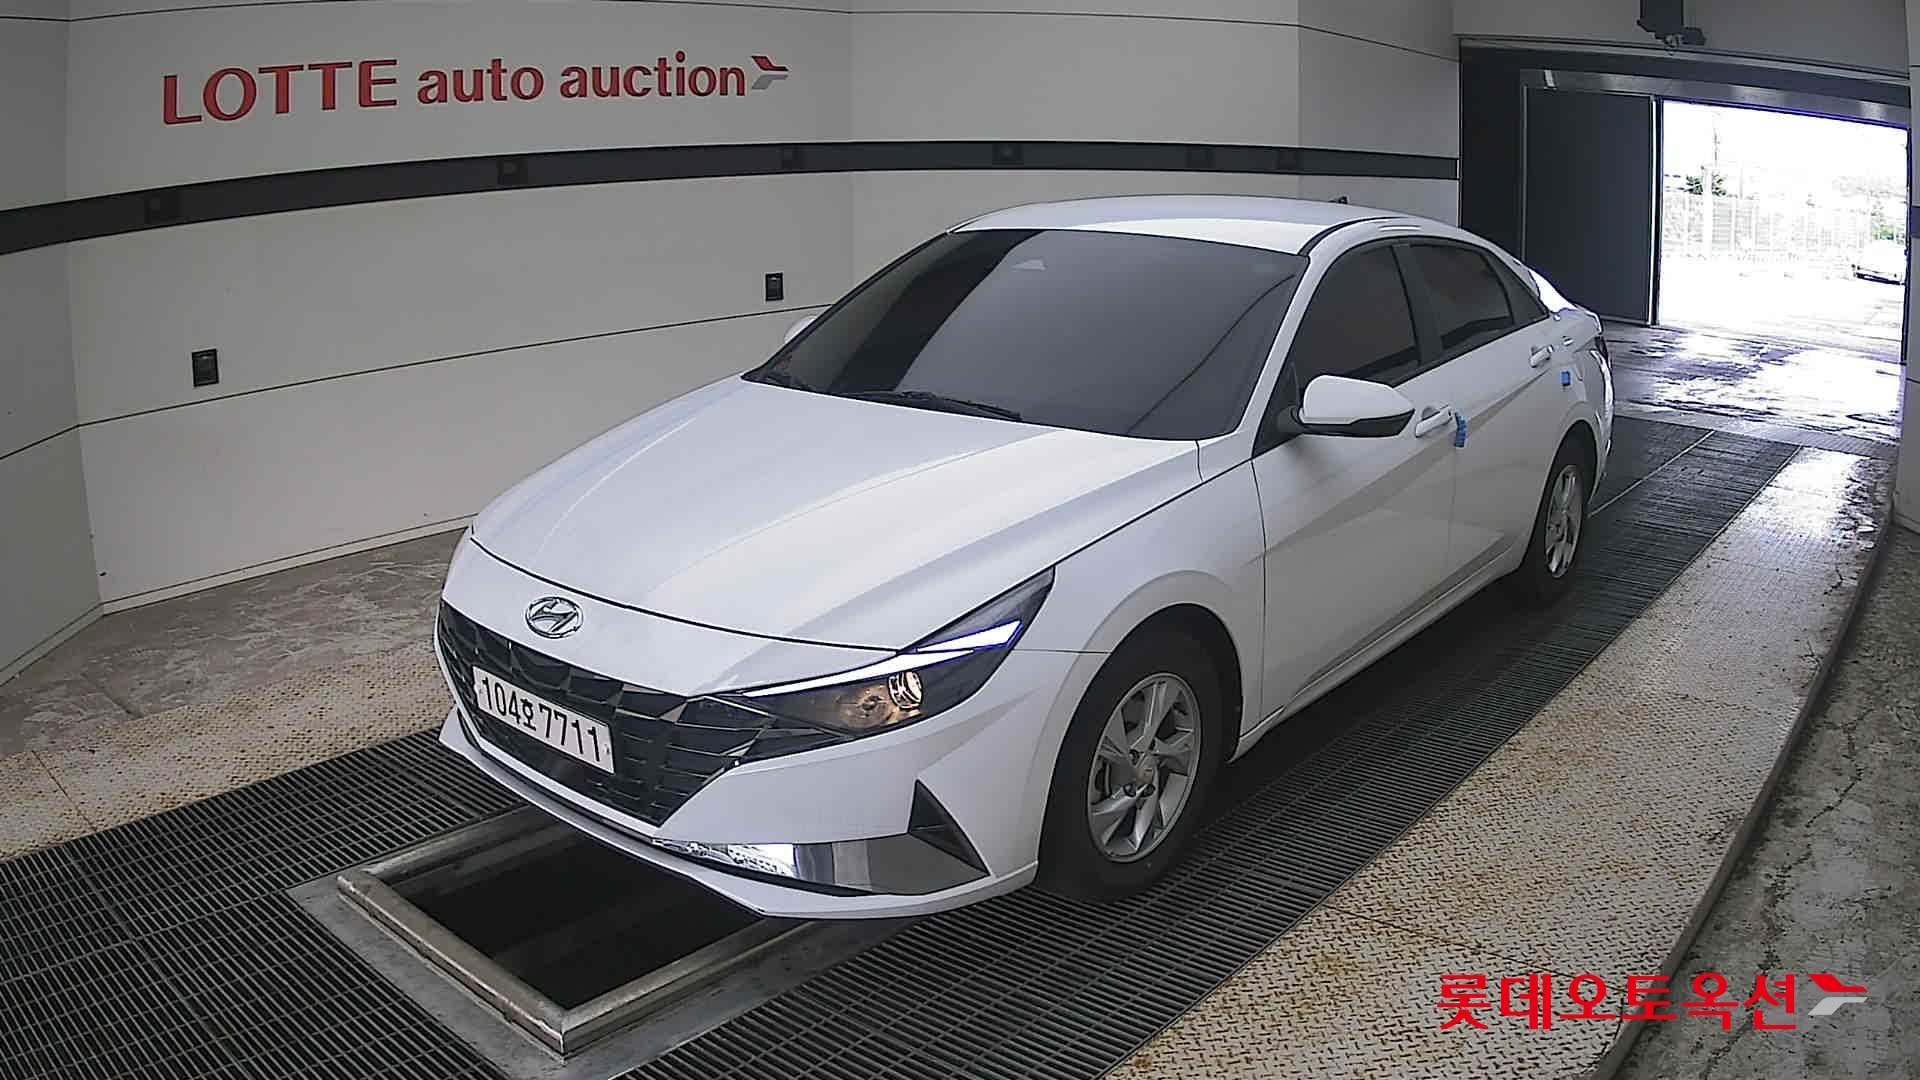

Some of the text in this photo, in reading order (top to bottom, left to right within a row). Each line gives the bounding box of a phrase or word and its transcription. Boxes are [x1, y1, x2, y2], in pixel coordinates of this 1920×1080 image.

[163, 51, 746, 125] LOTTE auto auction
